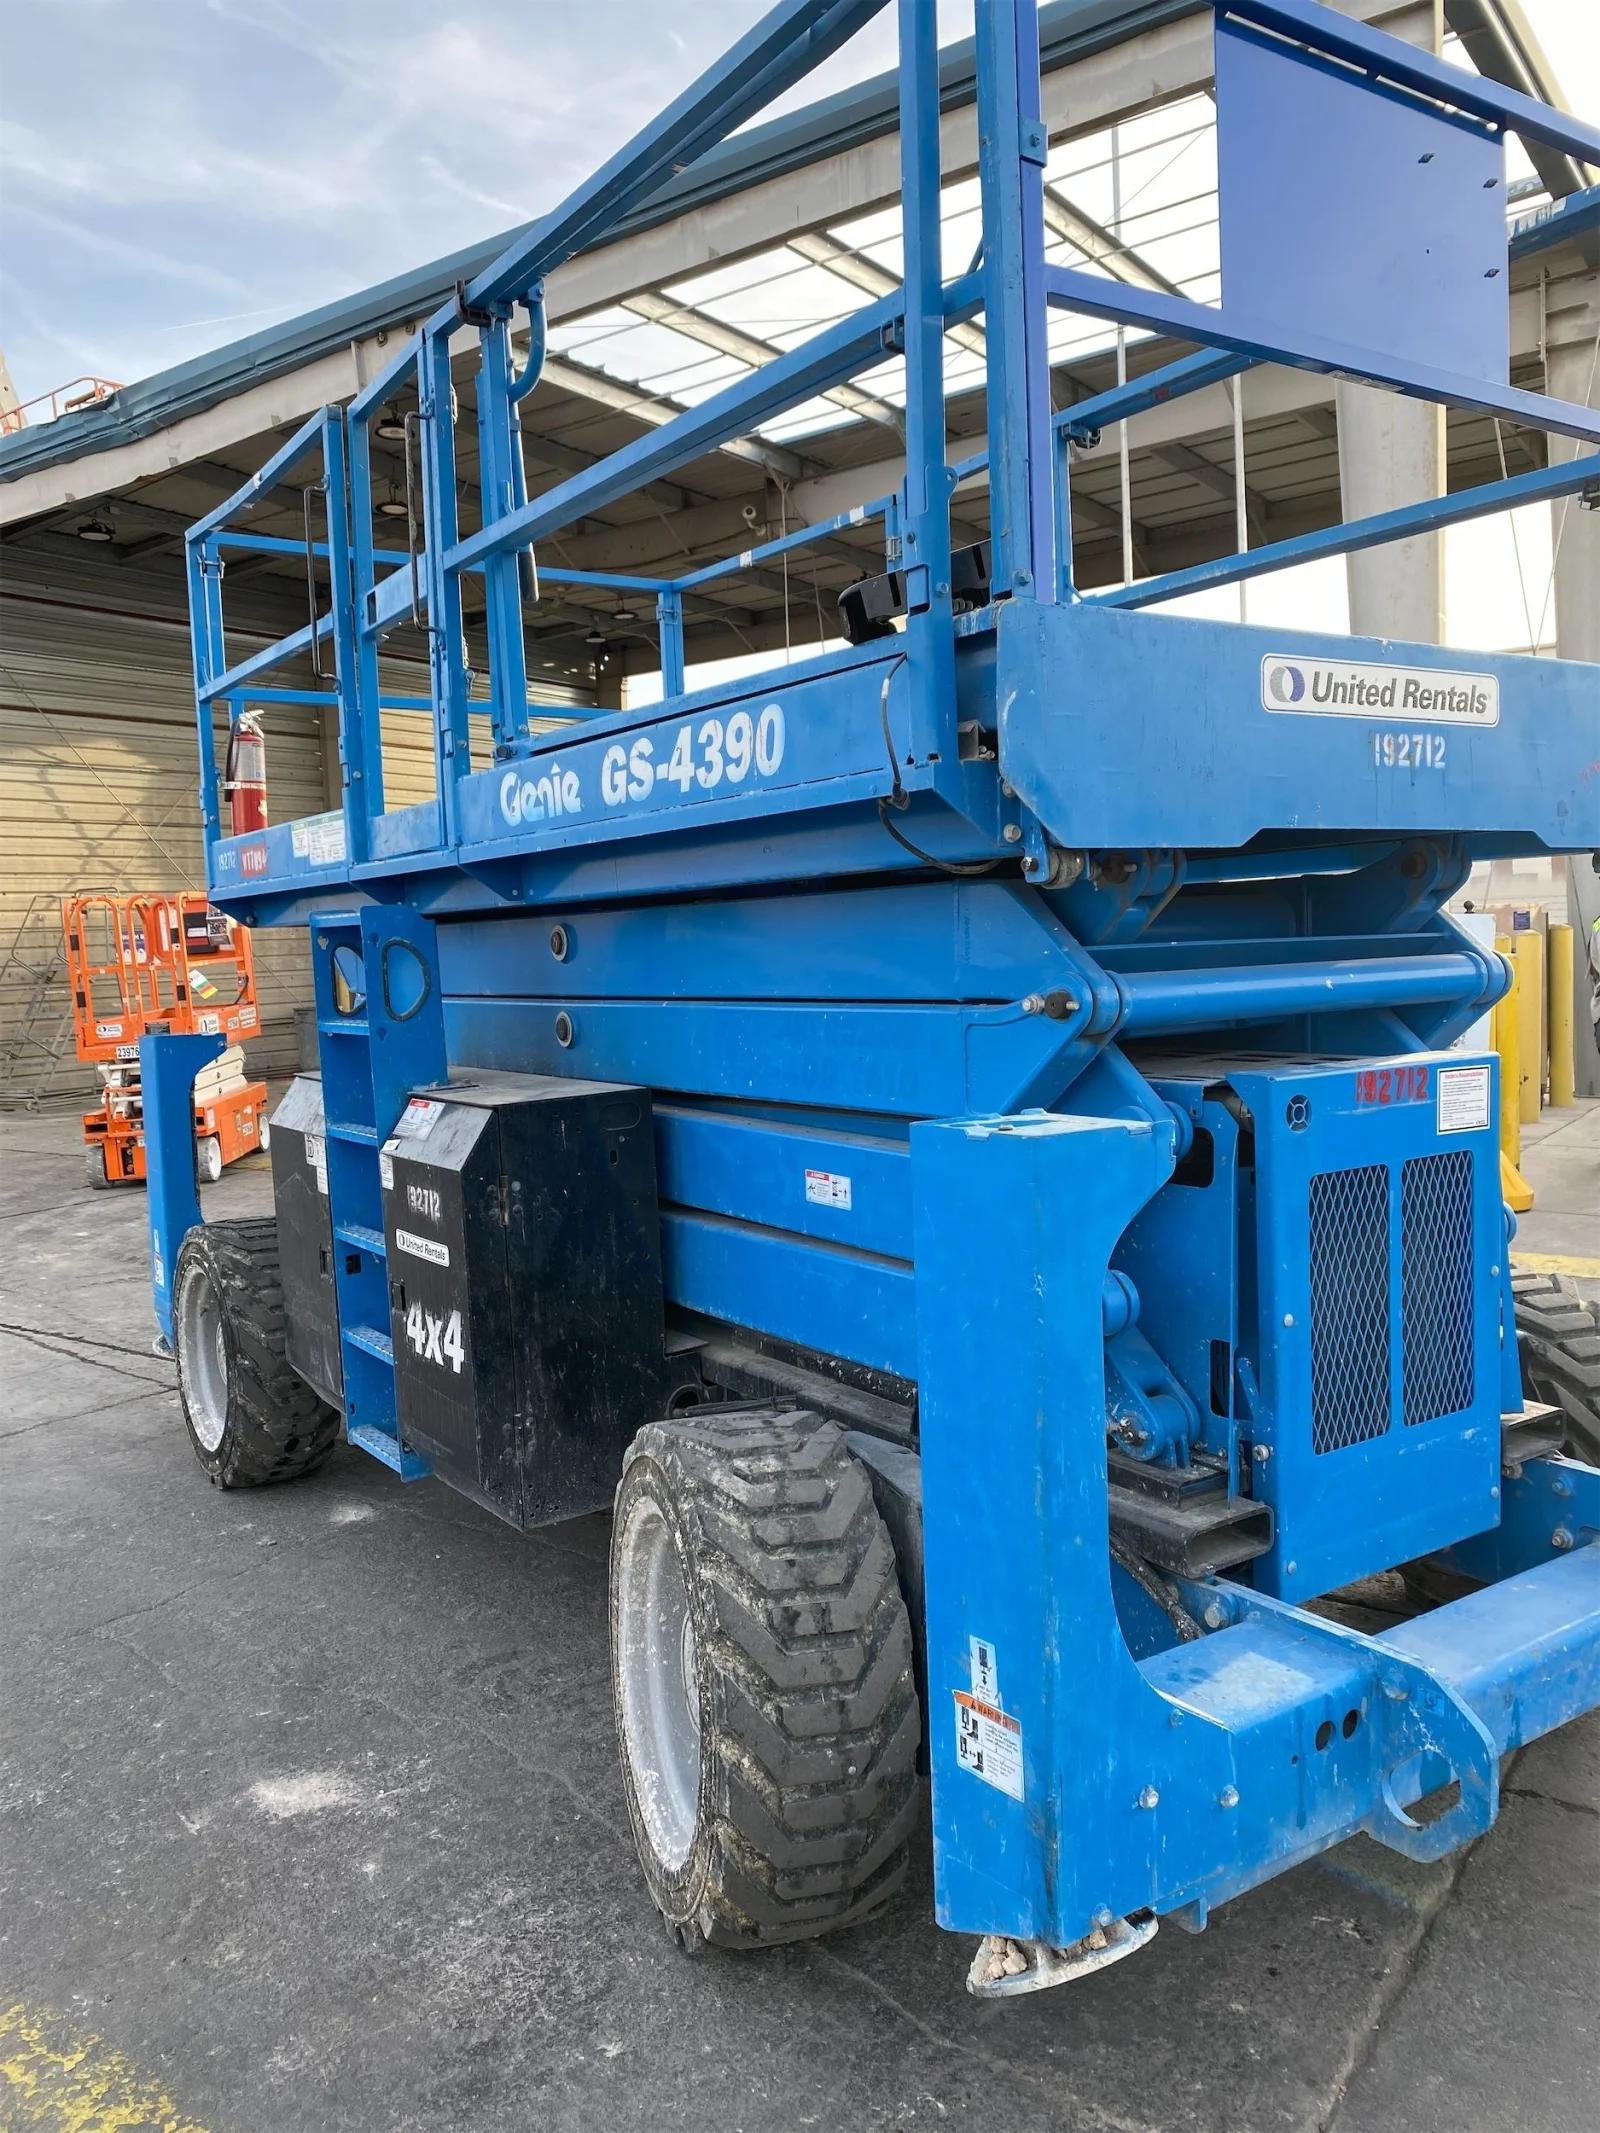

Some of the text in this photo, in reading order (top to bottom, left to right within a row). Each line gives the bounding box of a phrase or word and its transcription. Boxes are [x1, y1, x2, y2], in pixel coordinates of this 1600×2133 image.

[1311, 671, 1488, 714] United Rentals
[500, 703, 786, 827] Genie GS-4390
[1374, 732, 1446, 769] 192712
[1356, 1066, 1428, 1104] 192712
[405, 1236, 446, 1261] United Rentals
